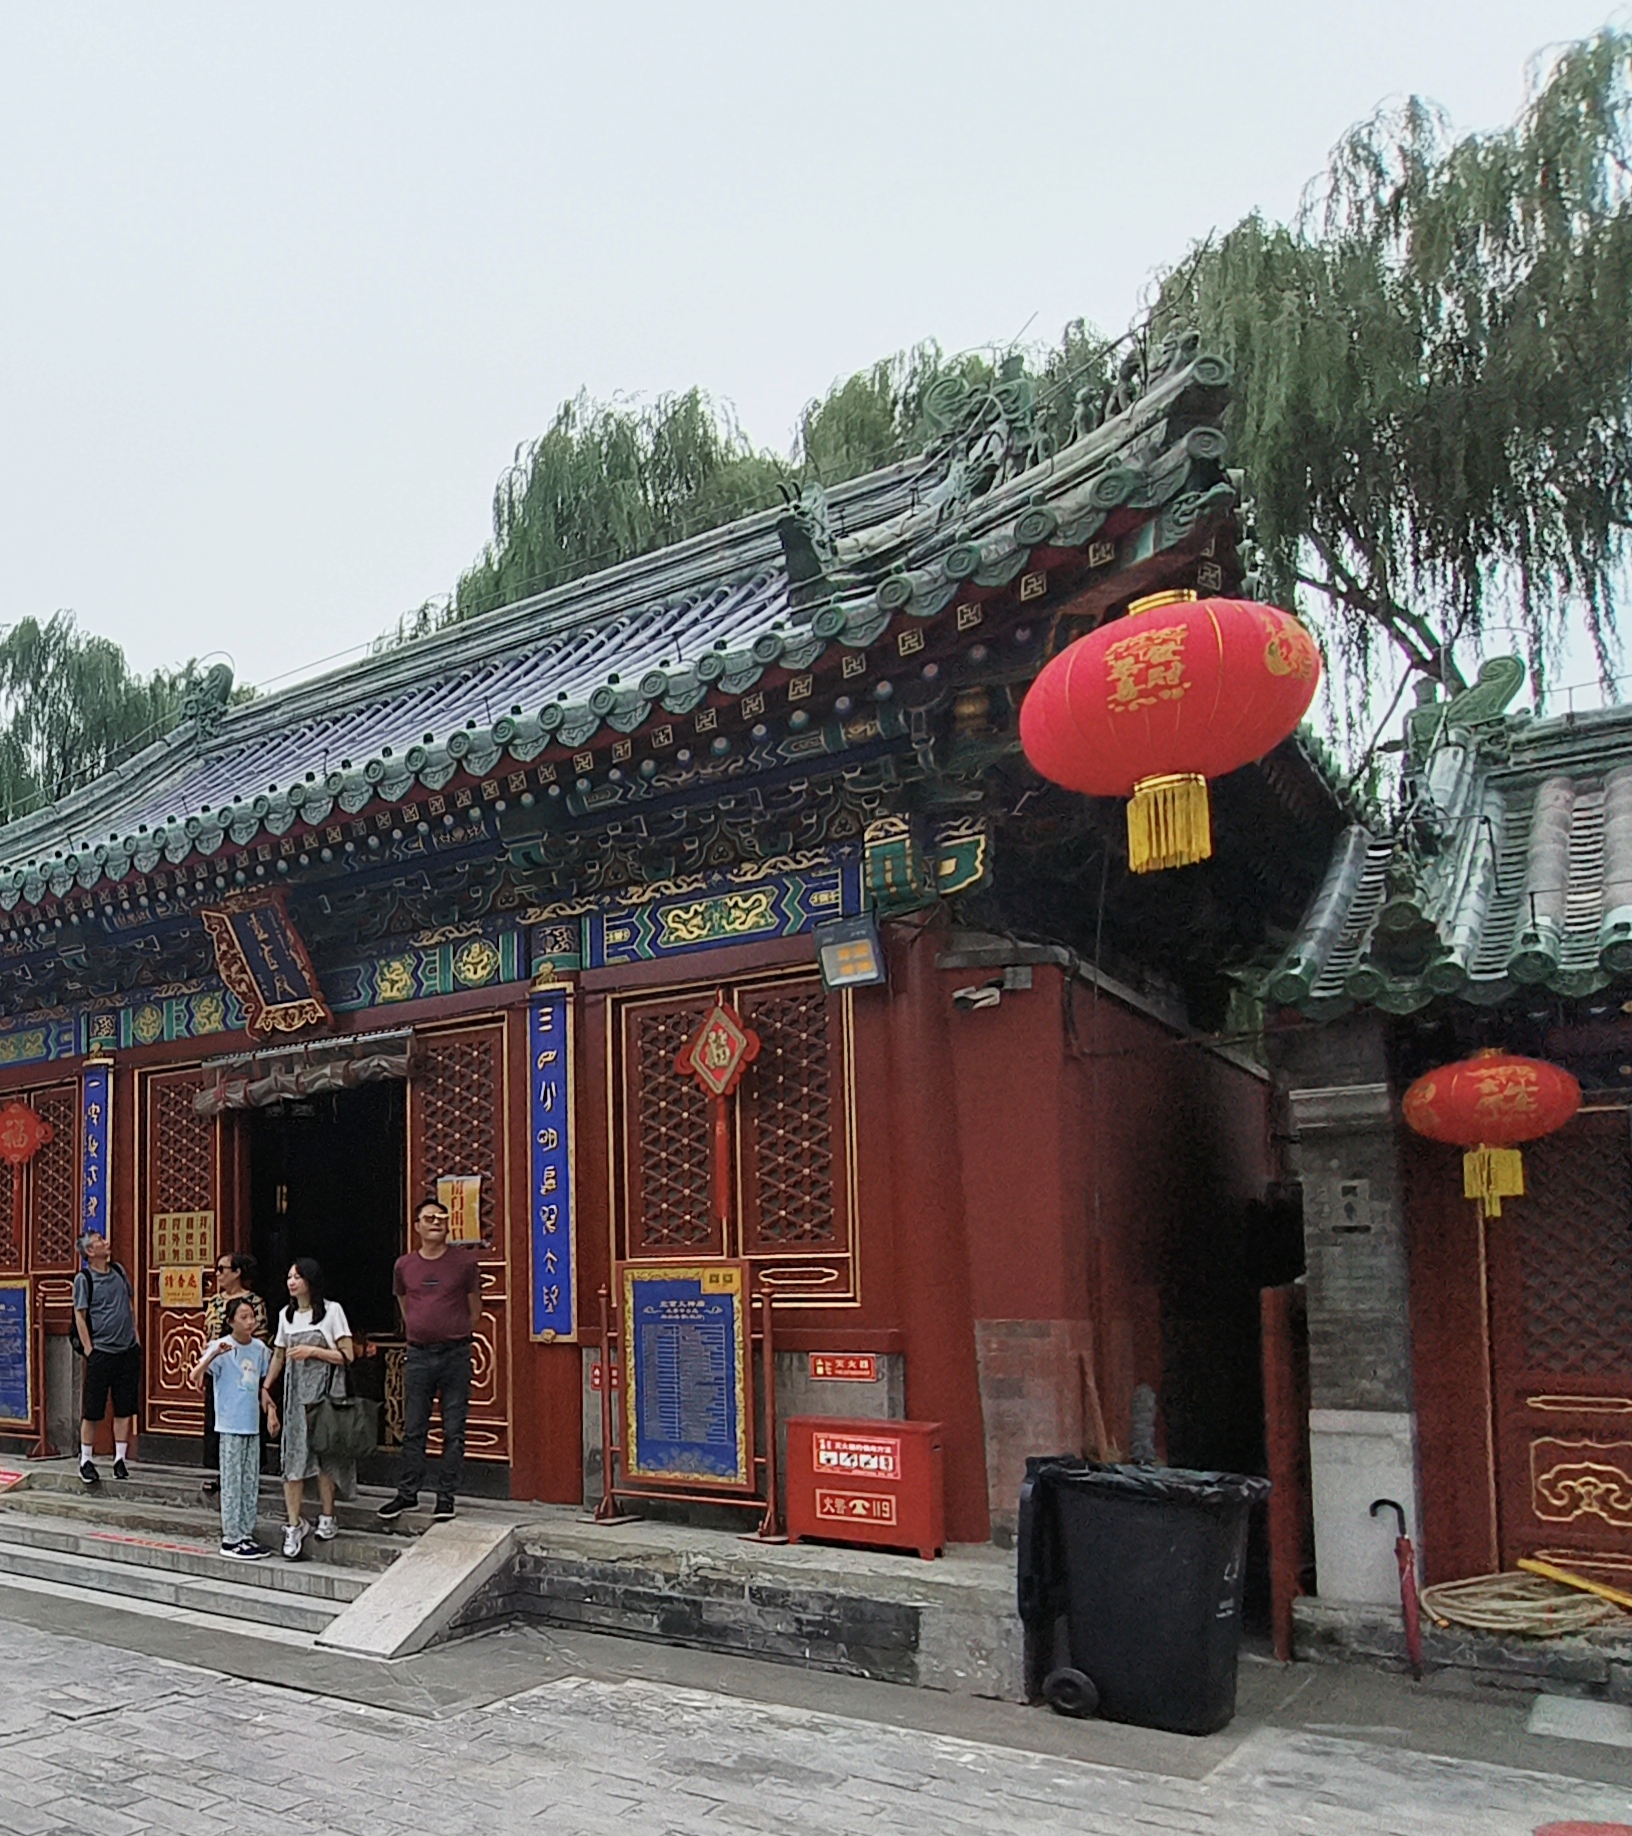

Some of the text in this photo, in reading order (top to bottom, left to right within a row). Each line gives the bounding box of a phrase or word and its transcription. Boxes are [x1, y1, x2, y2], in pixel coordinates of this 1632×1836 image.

[704, 1028, 730, 1070] 福
[1, 1119, 30, 1150] 福
[835, 1359, 869, 1370] 灭火器
[822, 1496, 890, 1518] 火警 119
